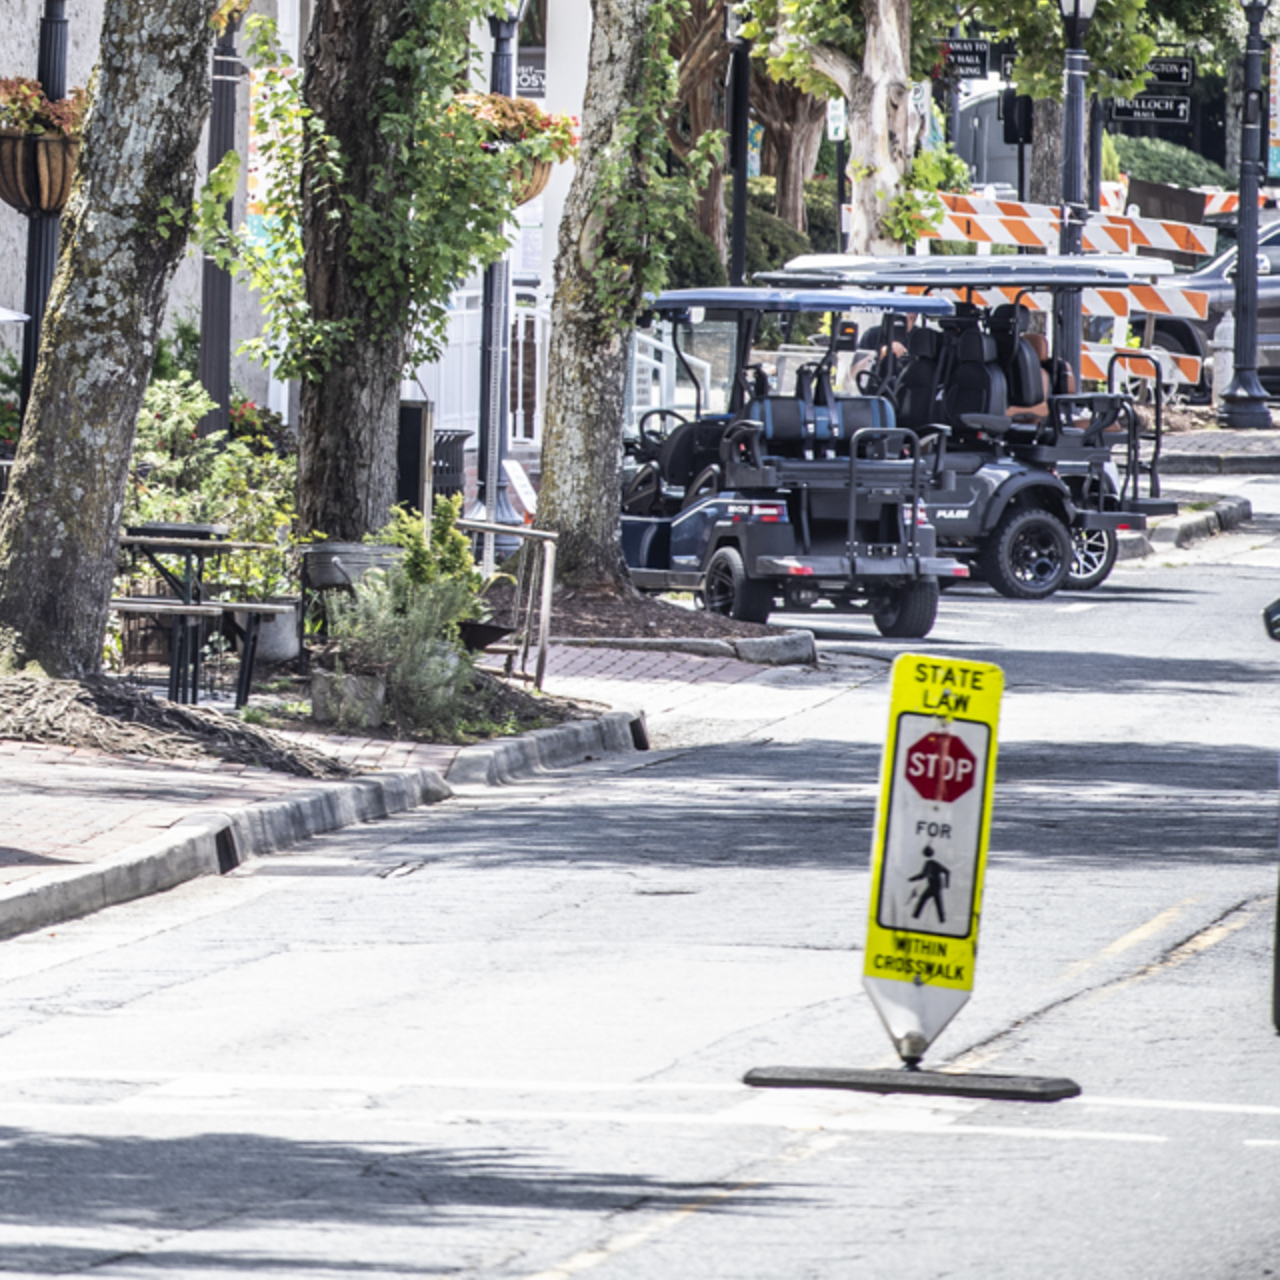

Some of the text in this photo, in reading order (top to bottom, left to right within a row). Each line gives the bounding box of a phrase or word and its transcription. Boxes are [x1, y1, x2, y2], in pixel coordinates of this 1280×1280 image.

[1117, 97, 1174, 111] BULLOCH
[915, 663, 984, 691] STATE
[923, 689, 971, 713] LAW
[908, 751, 973, 783] STOP
[915, 821, 953, 839] FOR
[894, 936, 949, 958] WITHIN
[874, 953, 966, 981] CROSSWALK
